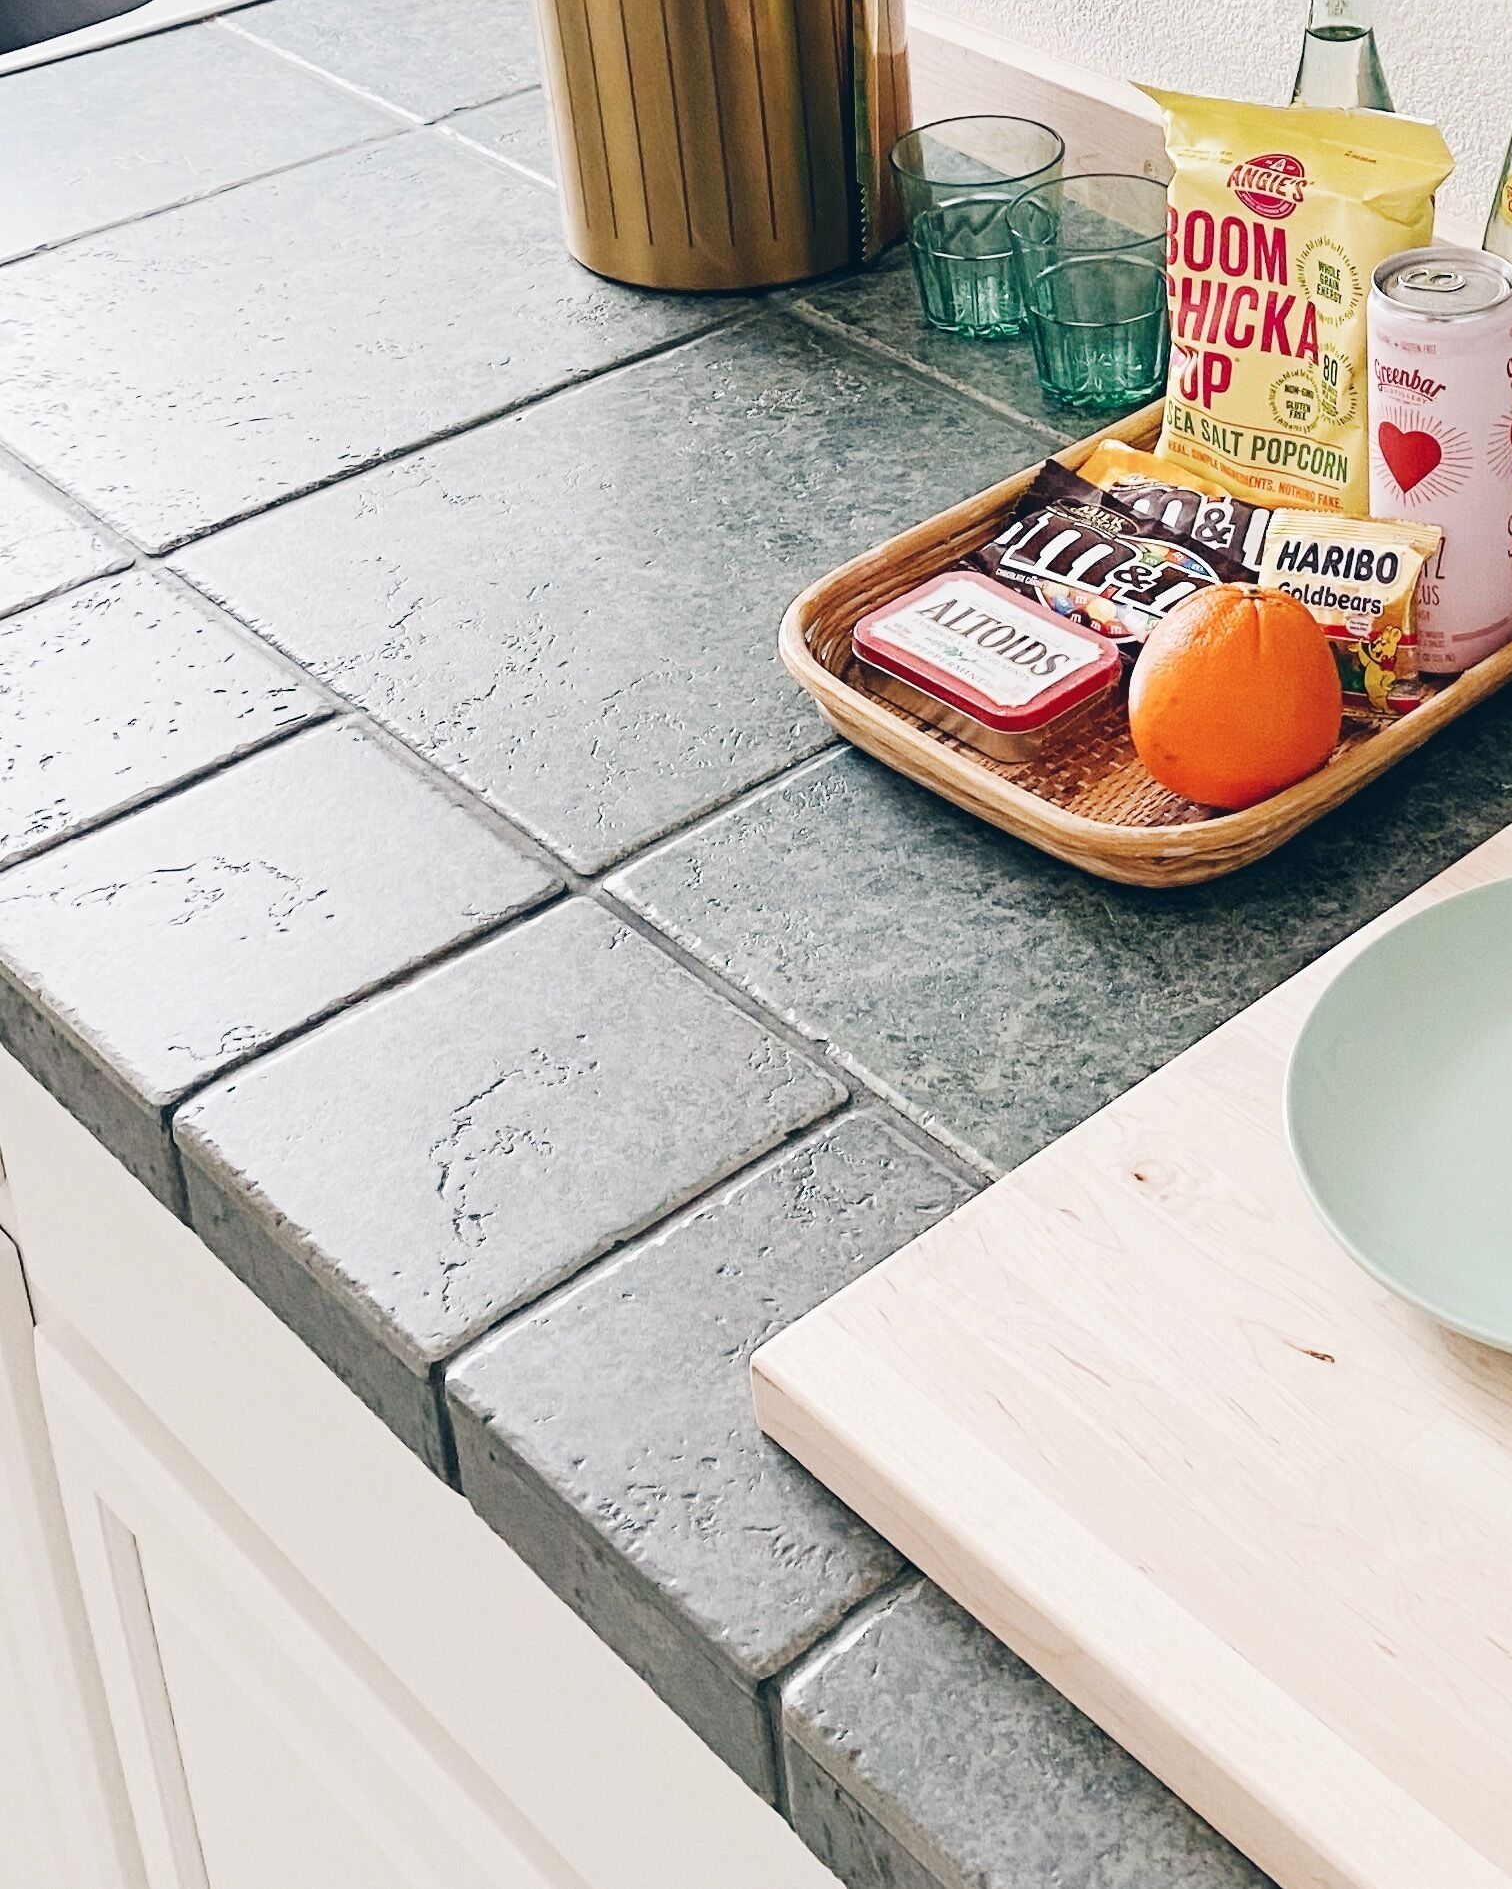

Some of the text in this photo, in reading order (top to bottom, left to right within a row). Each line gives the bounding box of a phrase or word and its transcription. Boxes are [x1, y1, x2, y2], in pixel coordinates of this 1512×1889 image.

[1226, 164, 1307, 203] ANGIE'S
[1318, 260, 1341, 281] WHOLE
[1320, 272, 1340, 292] GRAIN
[1317, 283, 1342, 304] ENERGY
[1174, 345, 1233, 409] OP
[1323, 354, 1338, 386] 80
[1375, 358, 1447, 399] Greenbar
[1284, 384, 1314, 399] NON-GMO
[1286, 400, 1311, 413] GLUTEN
[1289, 410, 1306, 421] FREE
[1167, 400, 1348, 483] SEA SALT POPCORN
[1279, 482, 1316, 502] NOTHING
[1318, 493, 1344, 509] FAKE.
[1079, 505, 1124, 528] MILK
[1276, 540, 1399, 585] HARIBO
[1278, 581, 1382, 615] Goldbears
[917, 599, 1070, 676] ALTOIDS
